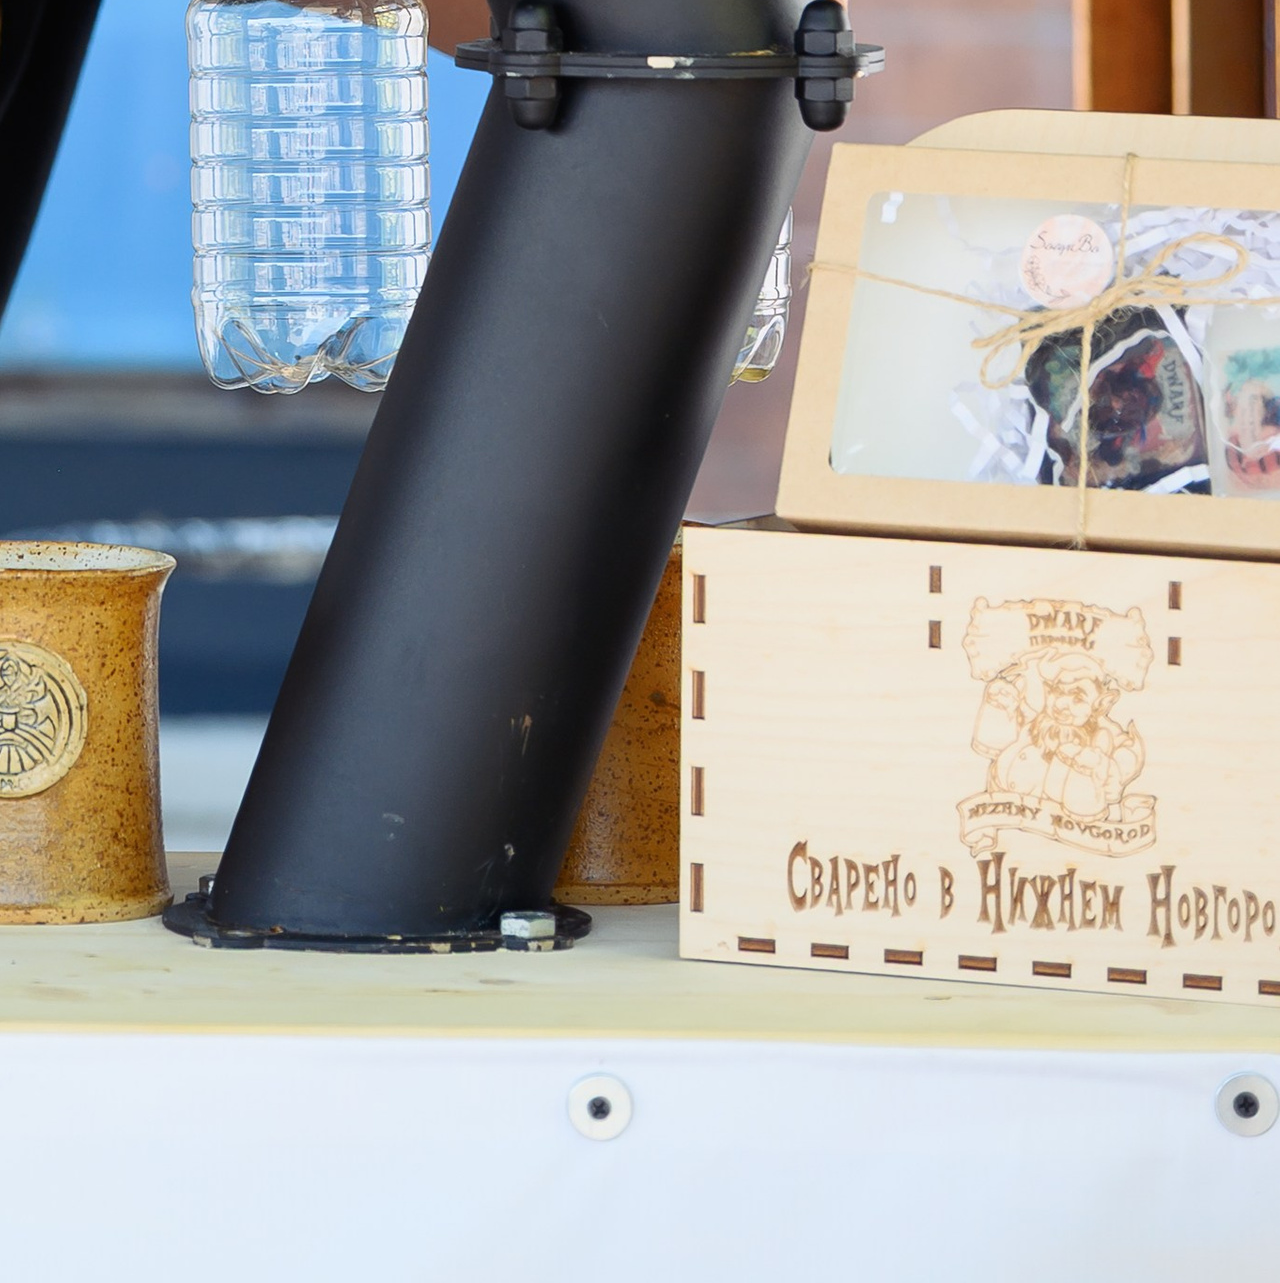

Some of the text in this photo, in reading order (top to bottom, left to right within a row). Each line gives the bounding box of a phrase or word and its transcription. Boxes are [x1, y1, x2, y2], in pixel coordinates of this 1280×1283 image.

[1162, 360, 1185, 424] DWARF
[1027, 610, 1103, 636] DWARF
[968, 801, 1151, 844] NIZHNY NOVGOROD
[1146, 865, 1280, 950] НОВГОРО
